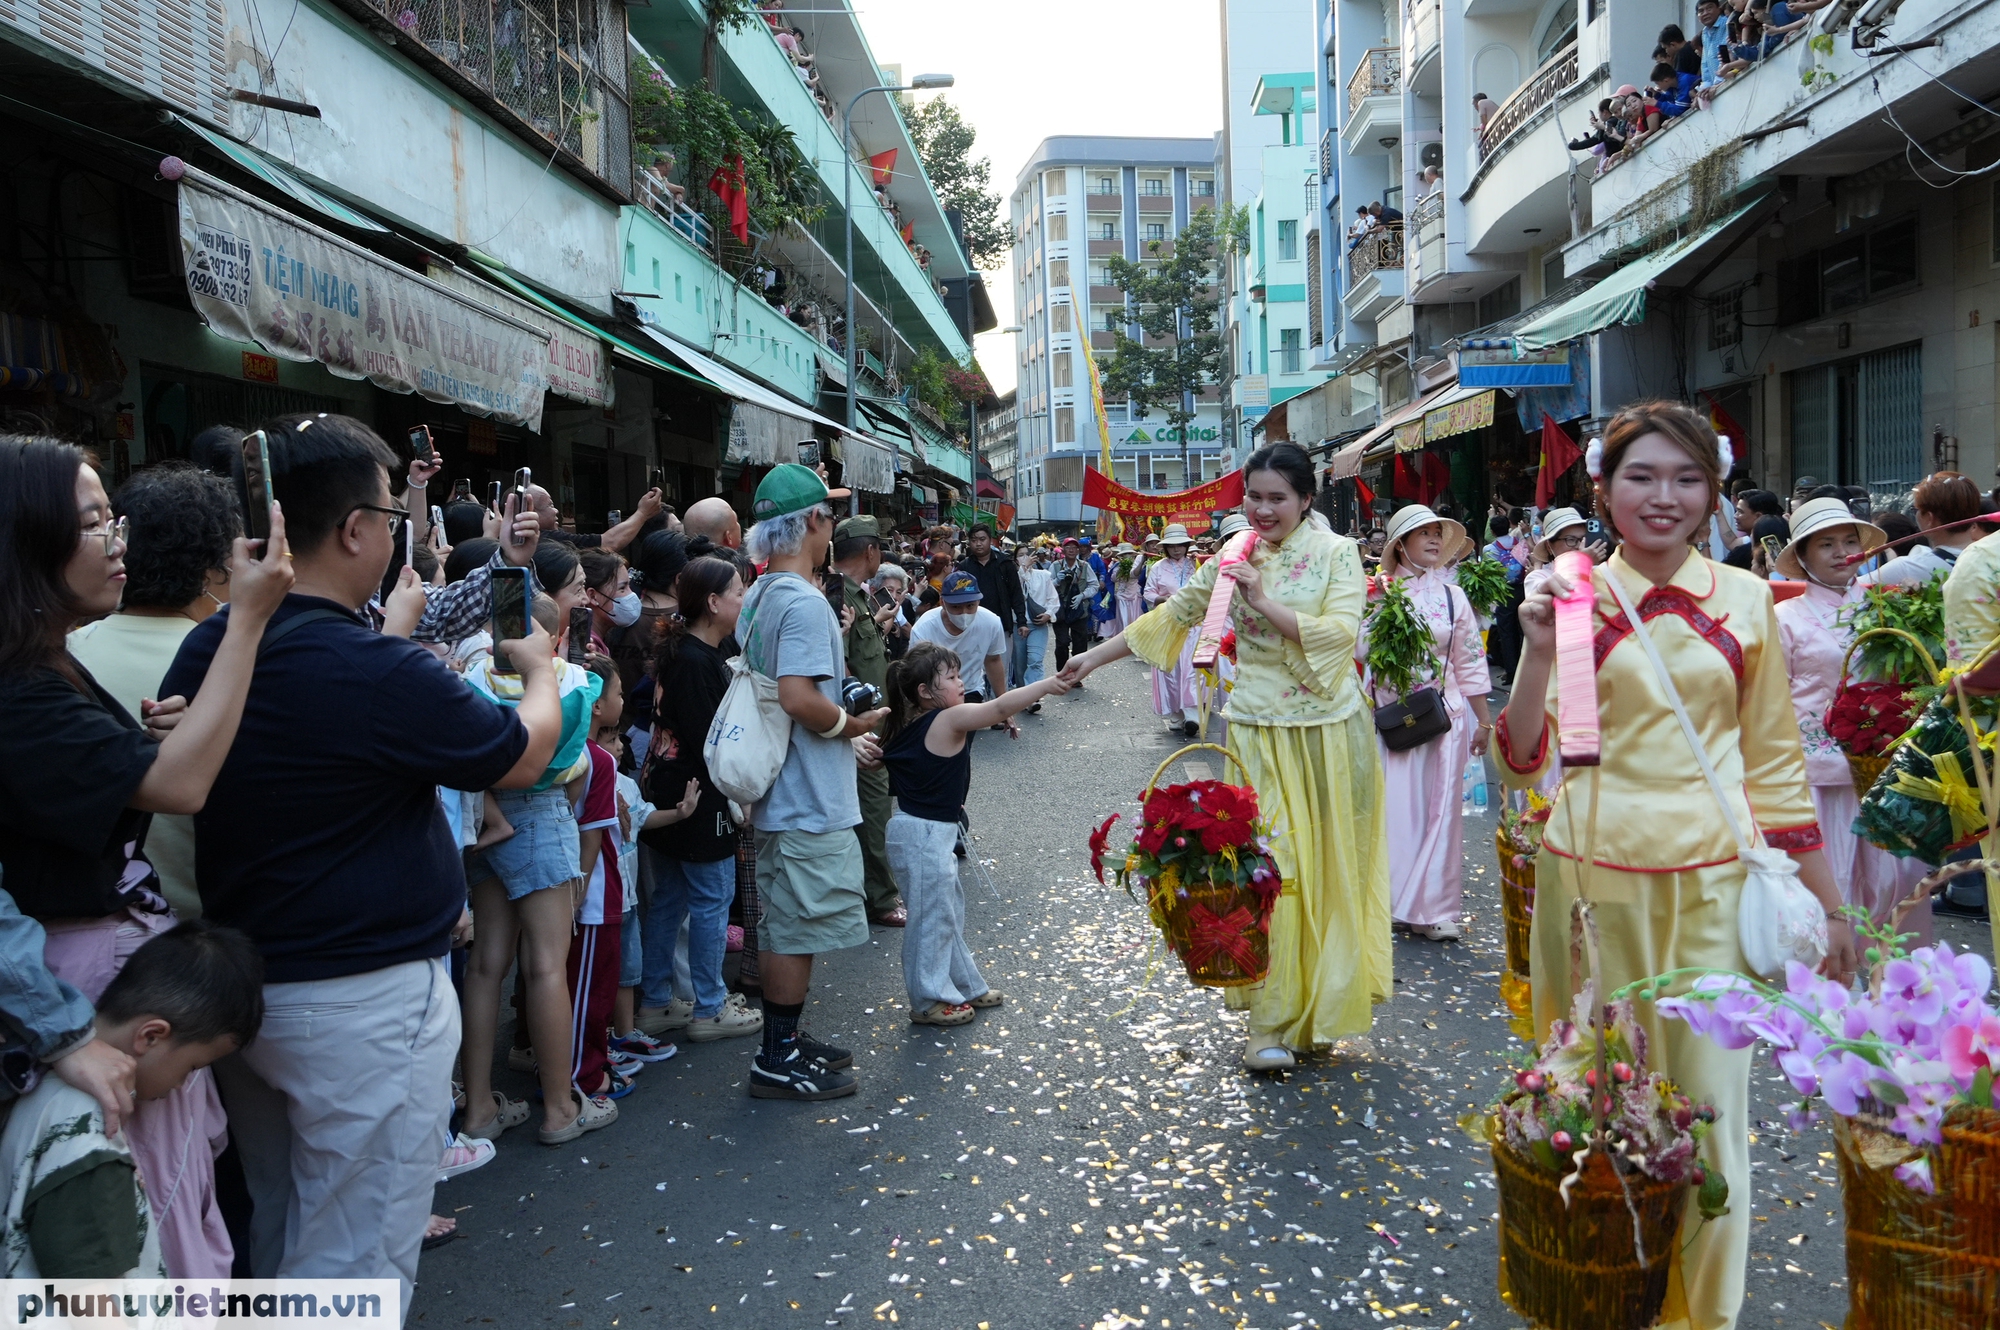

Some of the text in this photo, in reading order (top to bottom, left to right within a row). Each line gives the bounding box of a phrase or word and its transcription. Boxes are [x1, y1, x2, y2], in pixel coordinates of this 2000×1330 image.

[263, 244, 359, 318] TIỆM NHANG
[362, 350, 402, 379] CHUYÊN
[437, 318, 499, 375] THÀNH
